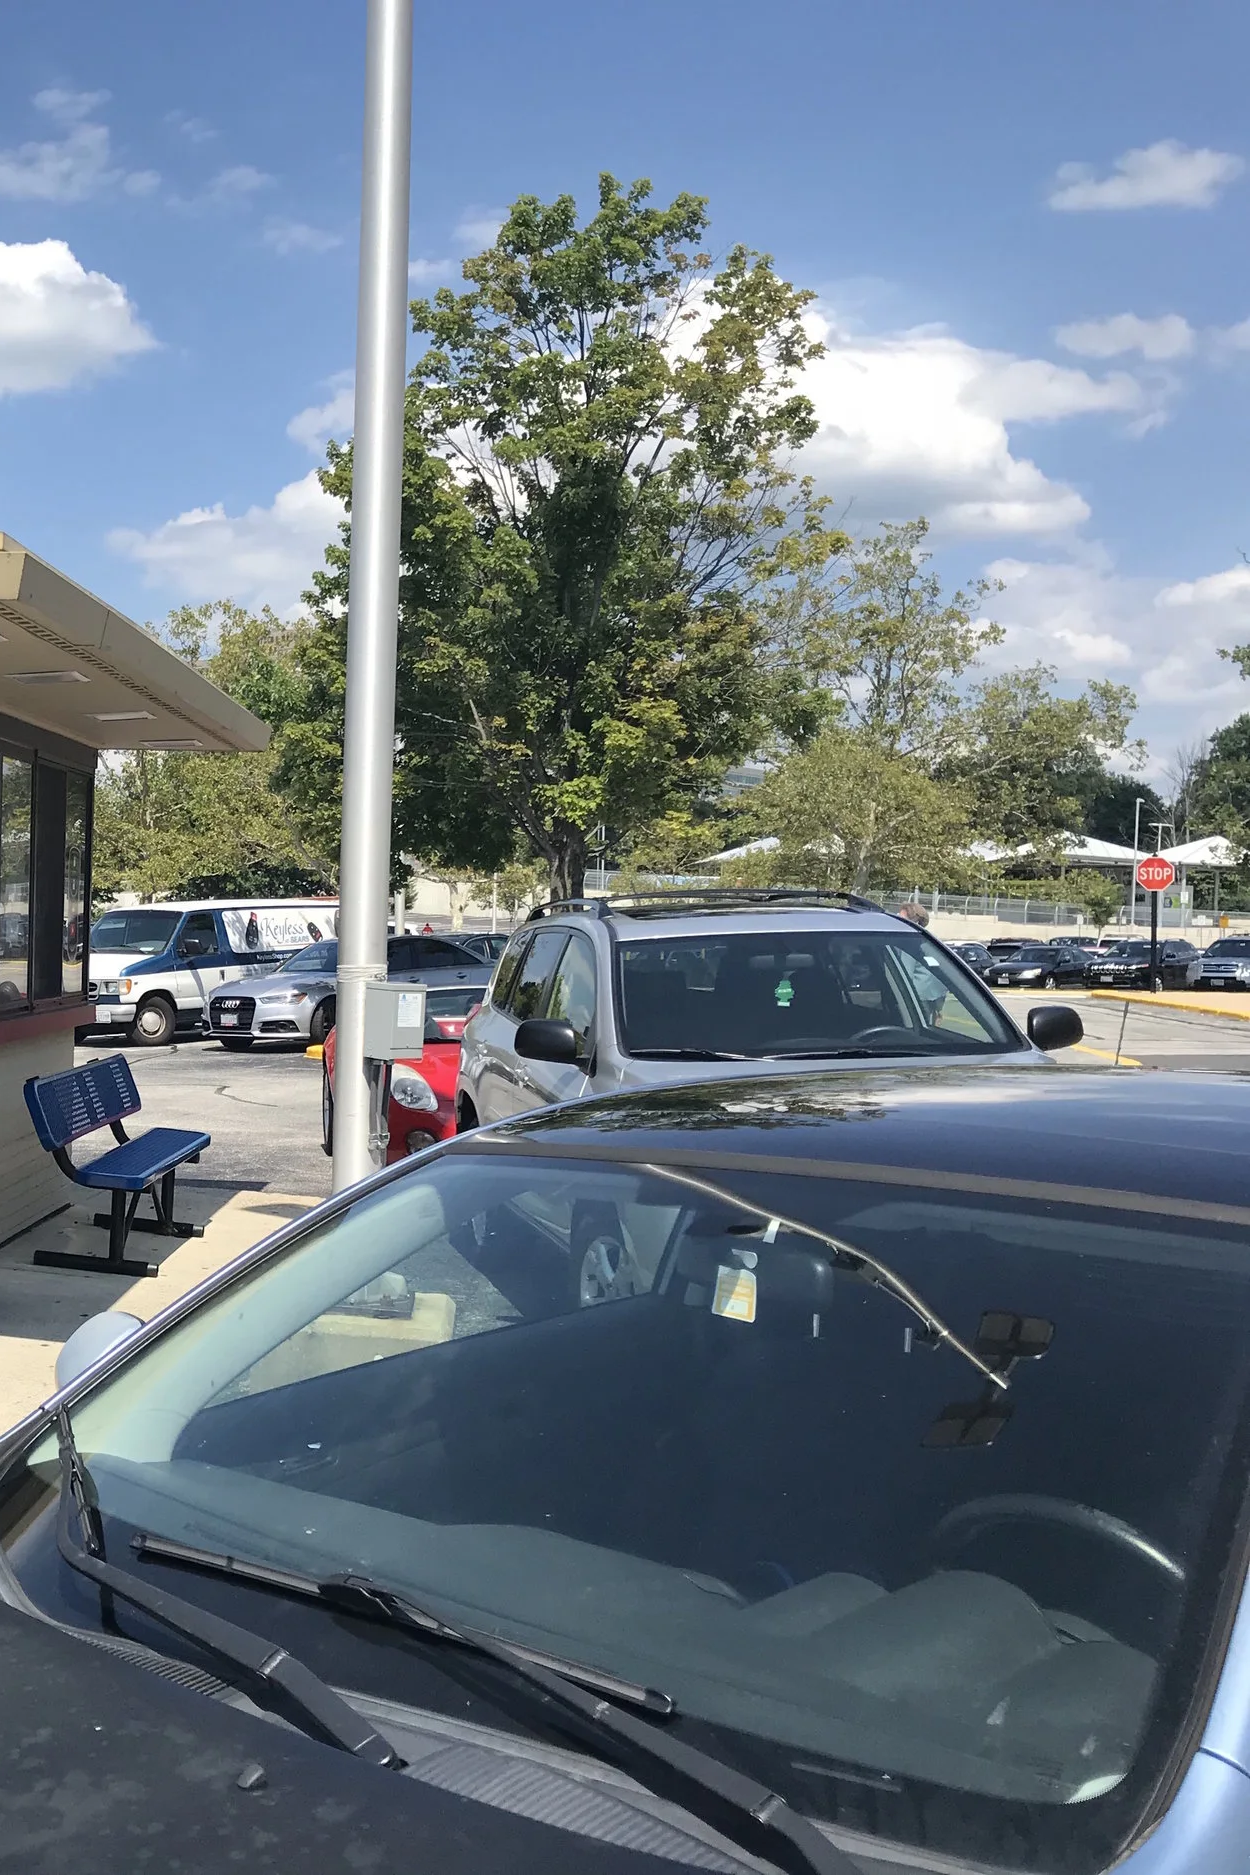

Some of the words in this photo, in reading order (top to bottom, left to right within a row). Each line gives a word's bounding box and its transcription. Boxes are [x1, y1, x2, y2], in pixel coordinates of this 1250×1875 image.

[1139, 867, 1171, 881] STOP
[261, 917, 304, 944] Keyless
[290, 935, 310, 943] SEARS
